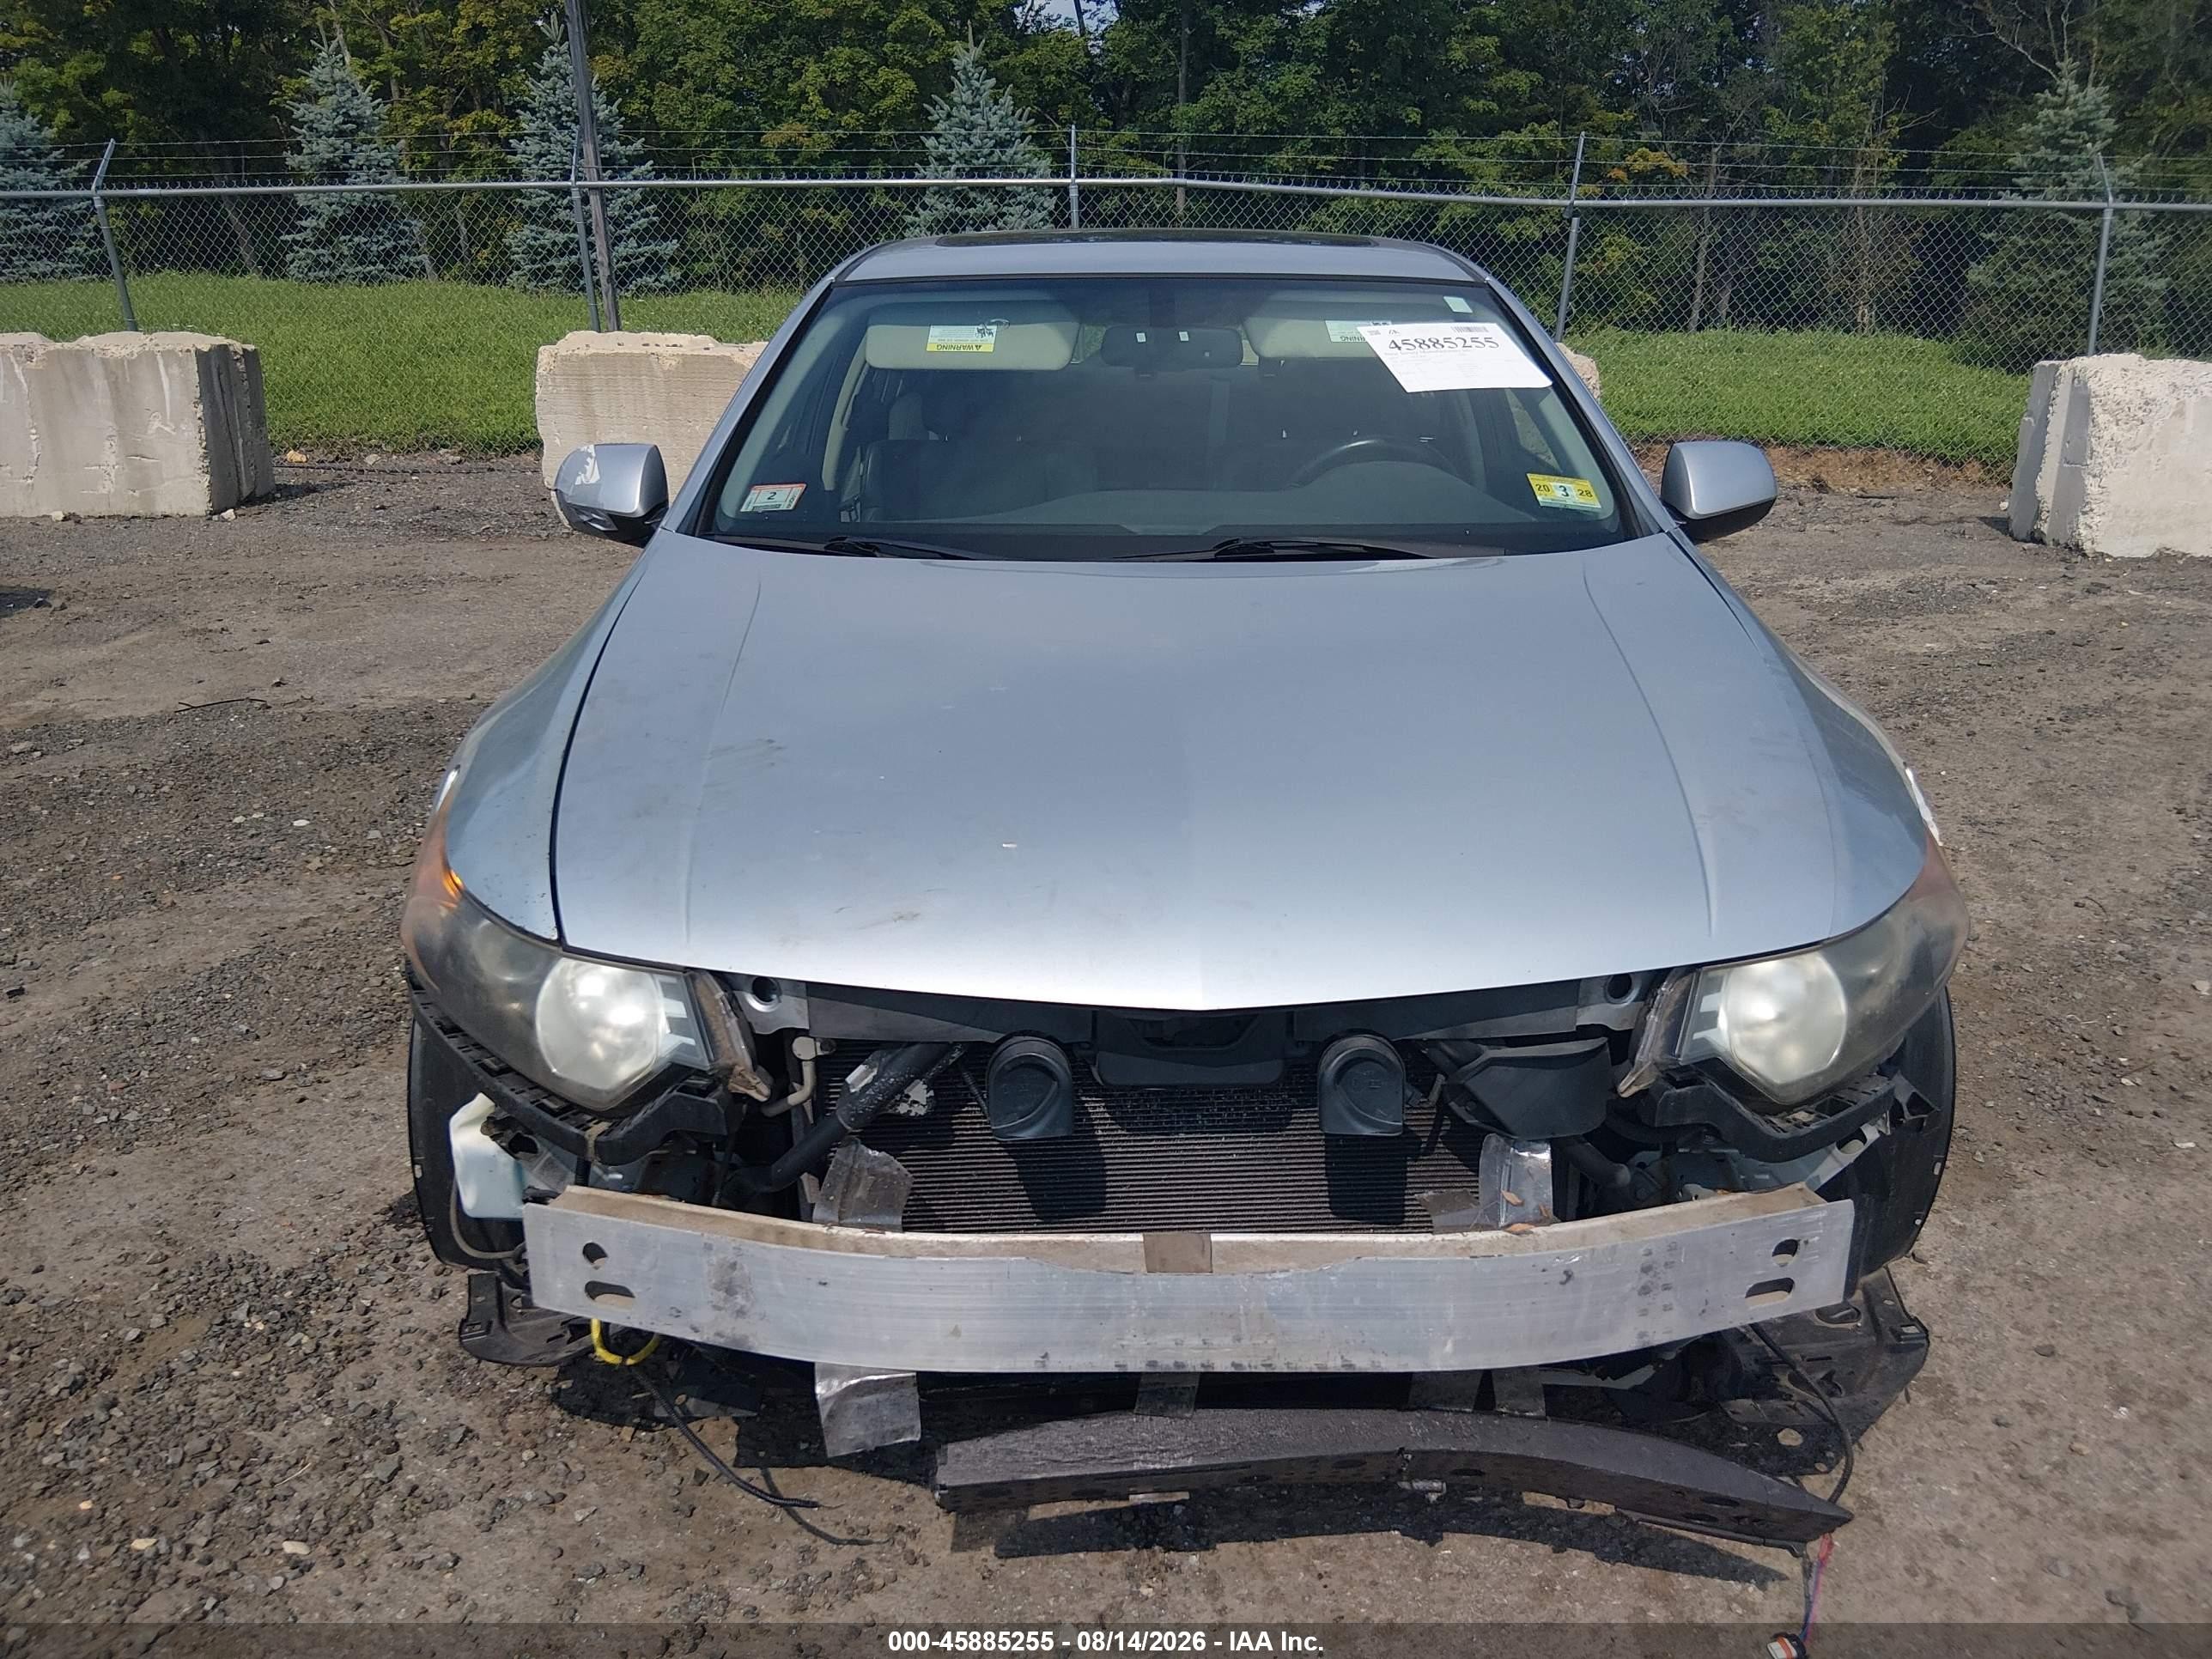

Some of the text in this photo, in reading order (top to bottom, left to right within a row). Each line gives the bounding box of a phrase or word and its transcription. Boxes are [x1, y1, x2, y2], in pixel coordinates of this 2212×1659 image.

[1389, 337, 1499, 351] 45885255
[767, 491, 777, 501] 2
[1535, 483, 1593, 498] 20 3 28
